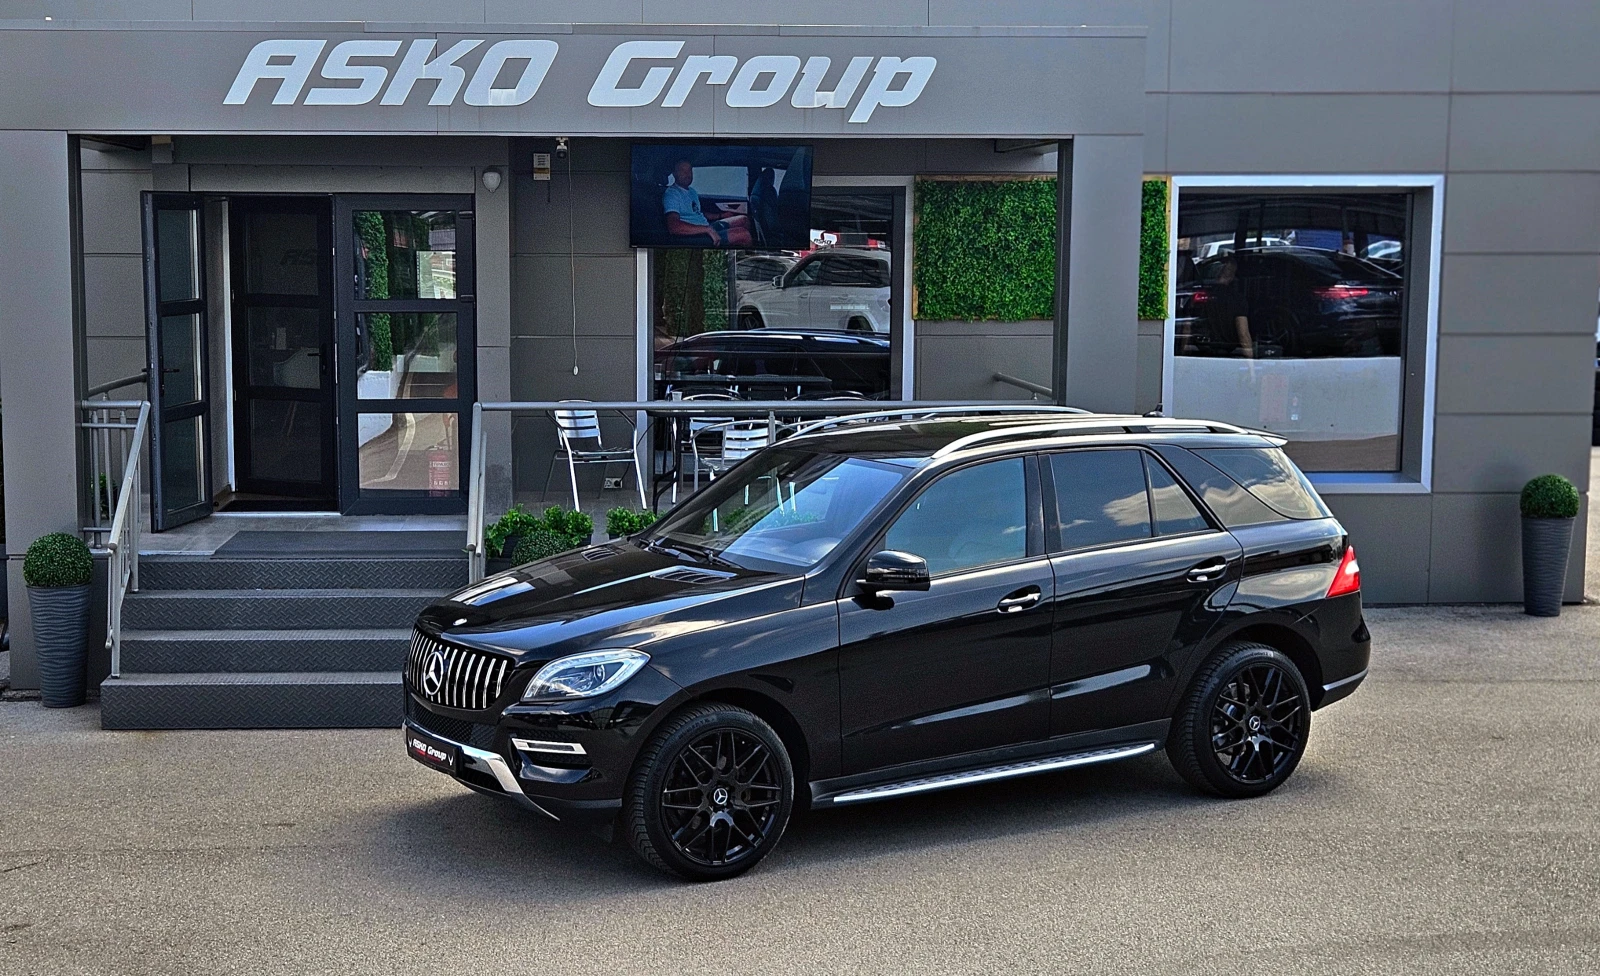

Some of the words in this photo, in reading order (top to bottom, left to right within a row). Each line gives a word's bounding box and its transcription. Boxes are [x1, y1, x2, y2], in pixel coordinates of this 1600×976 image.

[223, 39, 560, 107] ASKO
[587, 39, 938, 124] Group
[412, 738, 426, 751] ASKO
[427, 746, 447, 761] Group
